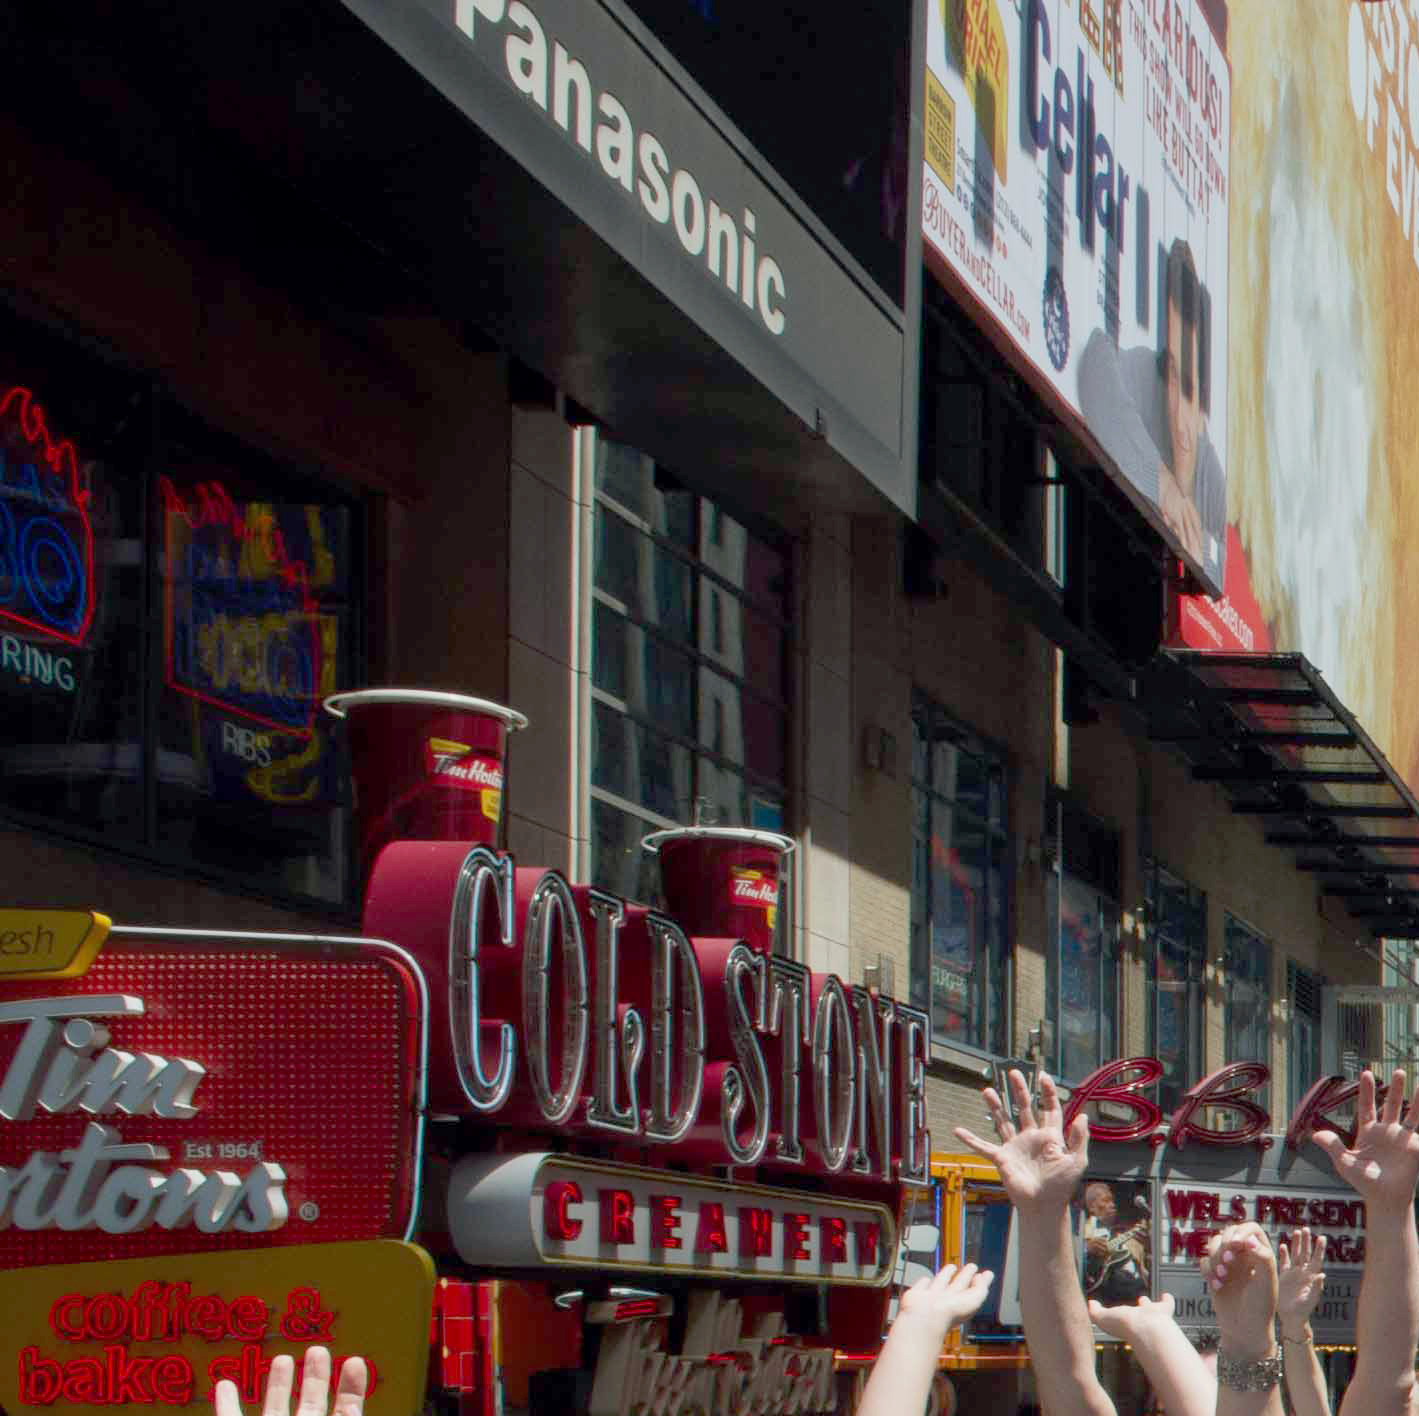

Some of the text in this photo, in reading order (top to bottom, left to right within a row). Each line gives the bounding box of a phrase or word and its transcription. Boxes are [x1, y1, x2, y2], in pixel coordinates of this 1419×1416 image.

[735, 879, 758, 898] Tim
[1, 924, 56, 957] esh
[449, 844, 931, 1185] COLD STONE
[0, 994, 207, 1120] Tim
[186, 1139, 262, 1159] Est 1964
[544, 1181, 881, 1267] CREAMERY
[47, 1279, 337, 1342] coffee &
[18, 1344, 193, 1405] bake
